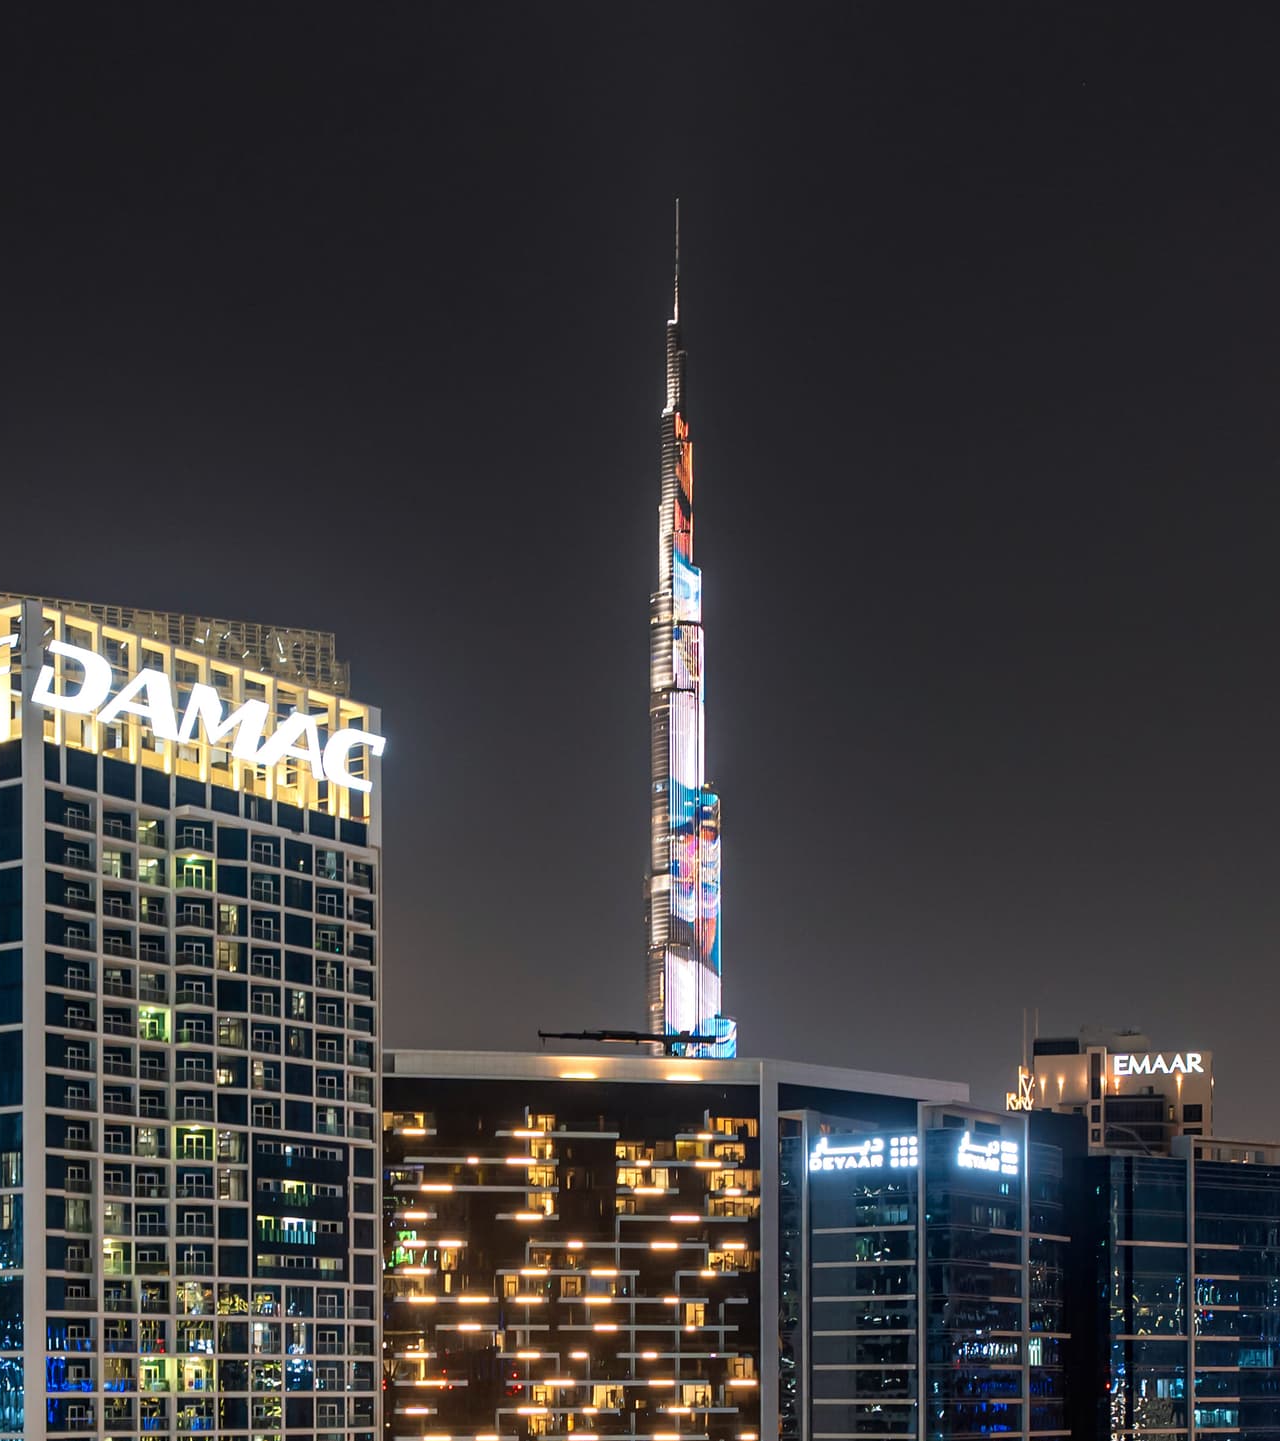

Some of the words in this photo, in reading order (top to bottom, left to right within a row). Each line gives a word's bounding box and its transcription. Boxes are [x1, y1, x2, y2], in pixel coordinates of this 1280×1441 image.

[31, 640, 386, 793] DAMAC
[1114, 1053, 1204, 1075] EMAAR
[809, 1155, 883, 1171] DEYAAR
